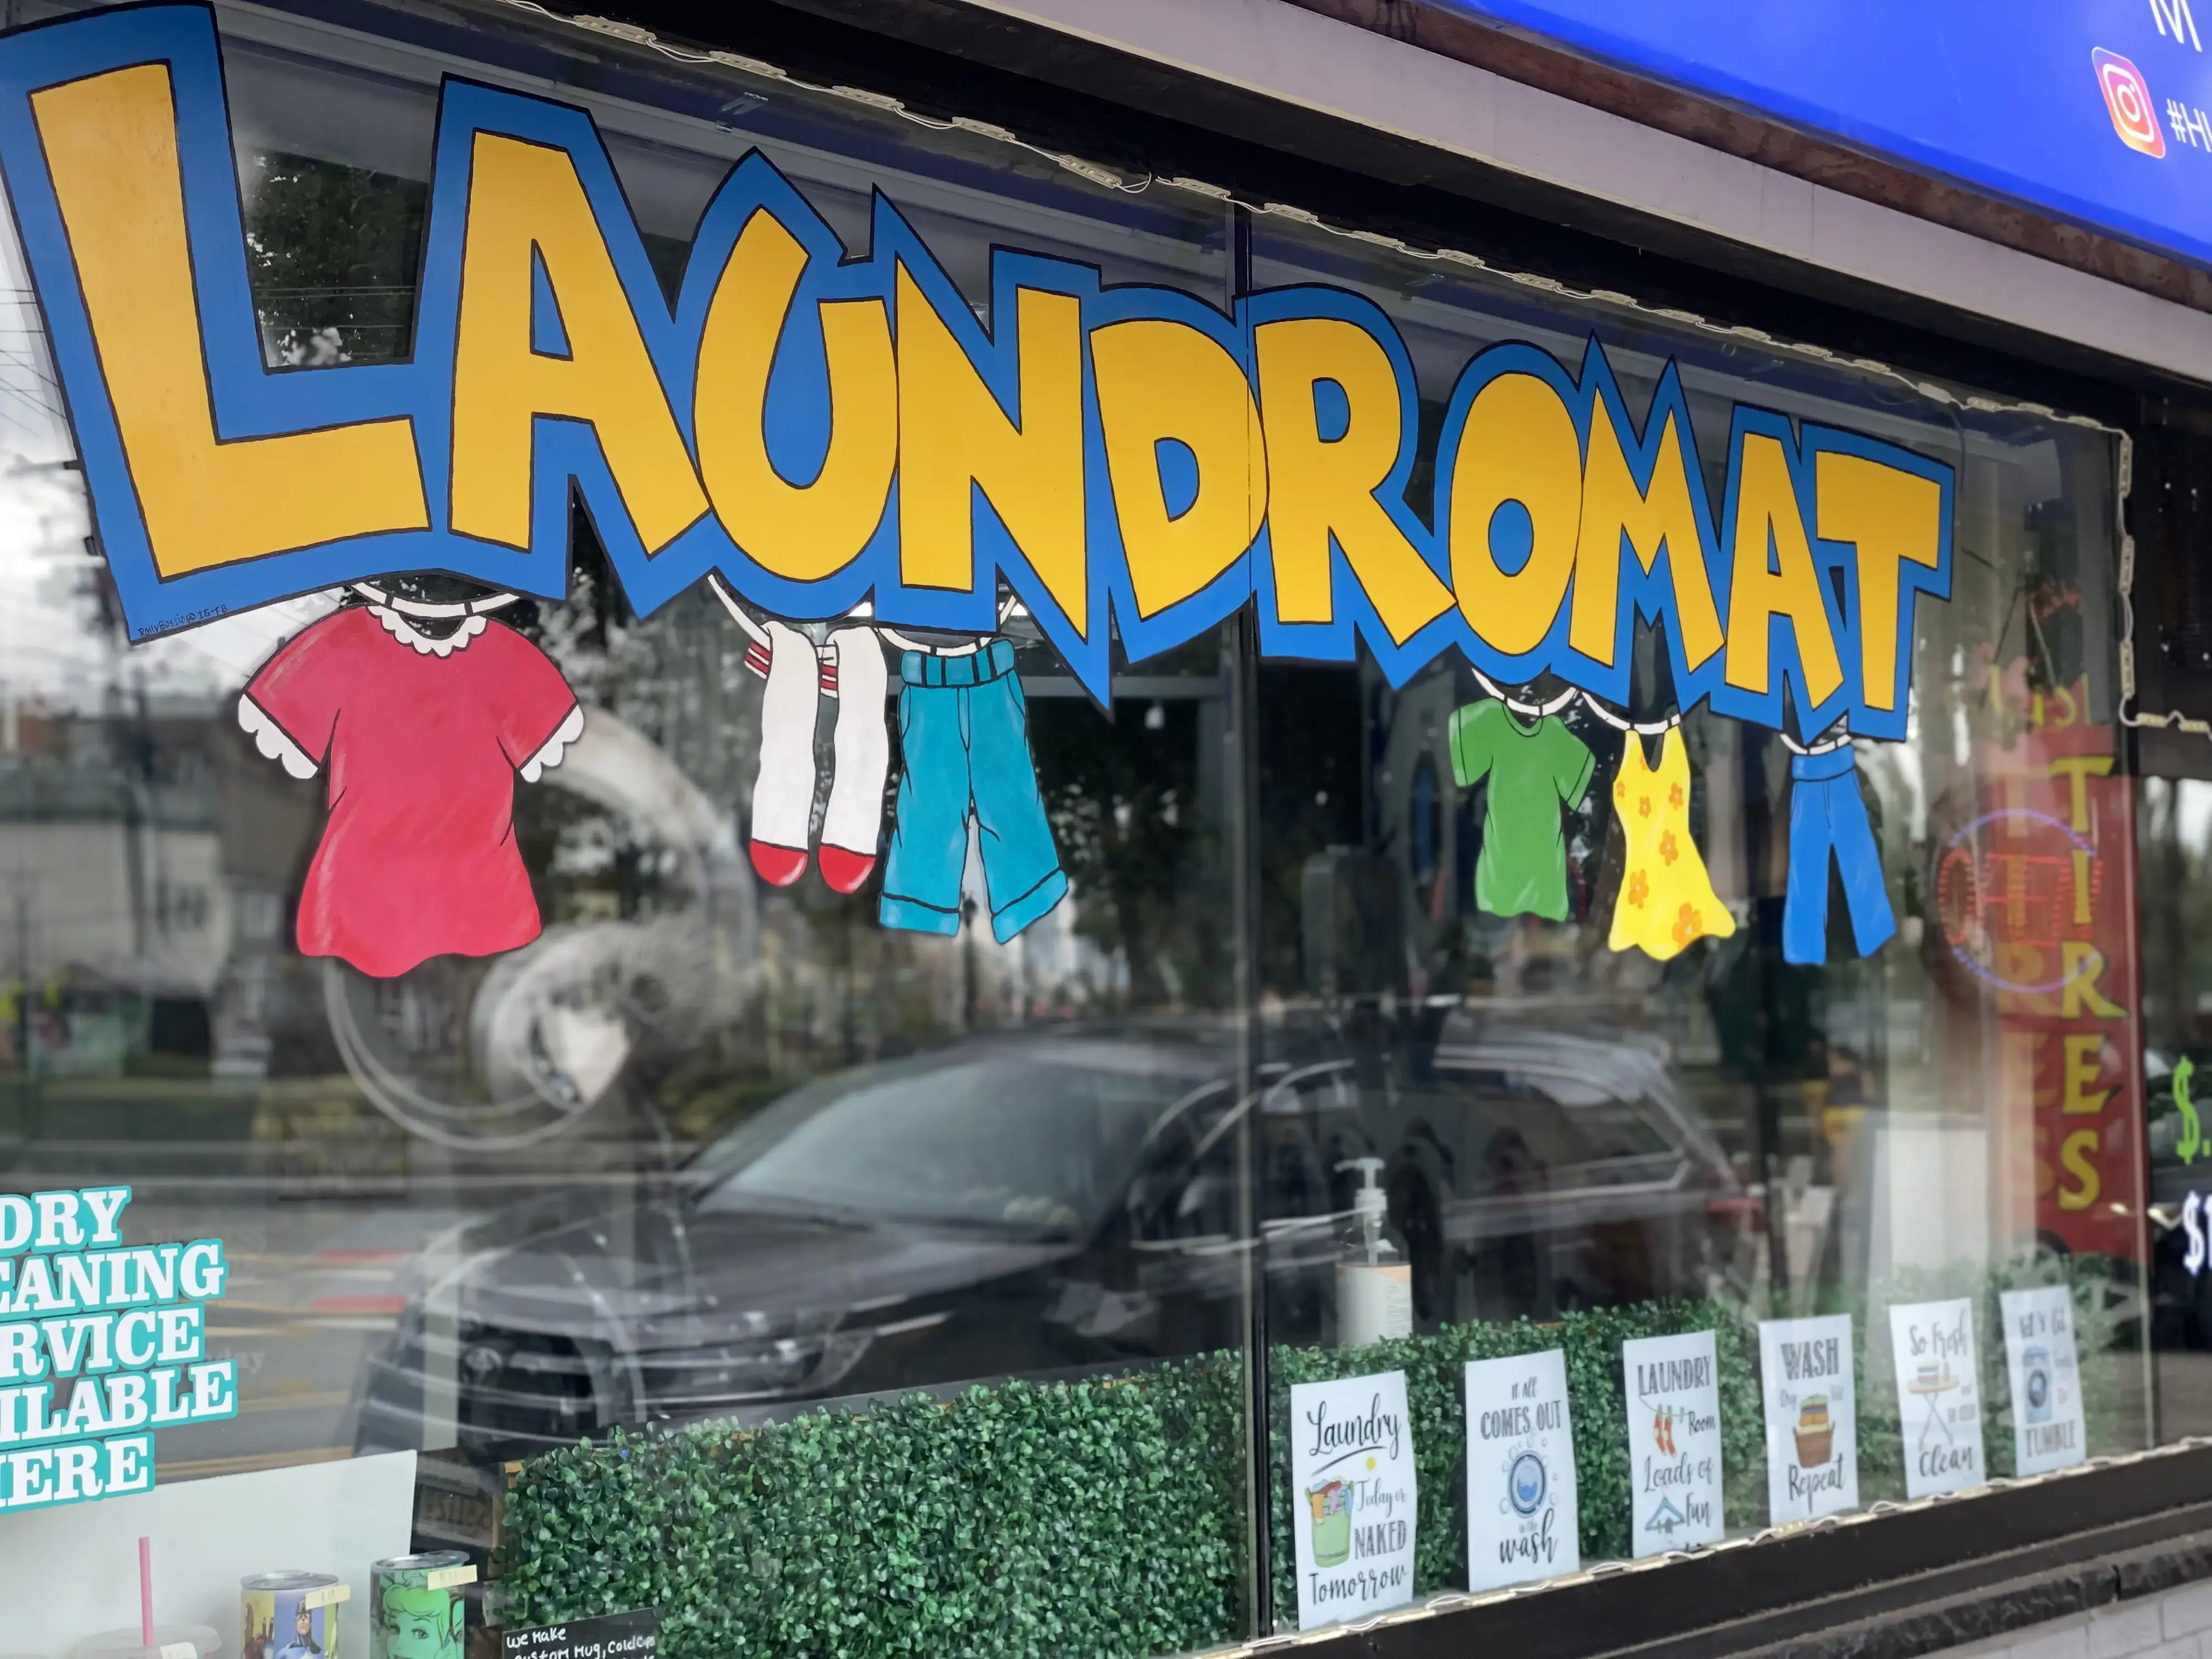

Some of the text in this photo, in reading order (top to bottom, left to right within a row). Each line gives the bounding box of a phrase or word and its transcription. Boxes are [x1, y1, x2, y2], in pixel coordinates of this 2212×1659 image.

[29, 59, 1944, 713] LAUNDROMAT
[2050, 756, 2130, 1210] TIRES
[0, 1189, 127, 1249] DRY
[0, 1307, 199, 1378] RVICE
[1780, 1338, 1839, 1381] WASH
[1637, 1355, 1711, 1396] LAUNDRY
[1307, 1392, 1401, 1460] Laundry
[1481, 1400, 1561, 1440] COMES OUT
[1688, 1410, 1716, 1436] Room
[1644, 1451, 1714, 1493] Loads of
[1788, 1454, 1846, 1514] Repeat
[1353, 1478, 1408, 1518] Today or
[1686, 1492, 1711, 1528] Fun
[1354, 1520, 1407, 1560] NAKED
[1499, 1508, 1558, 1564] wash
[1307, 1564, 1408, 1606] Tomorrow
